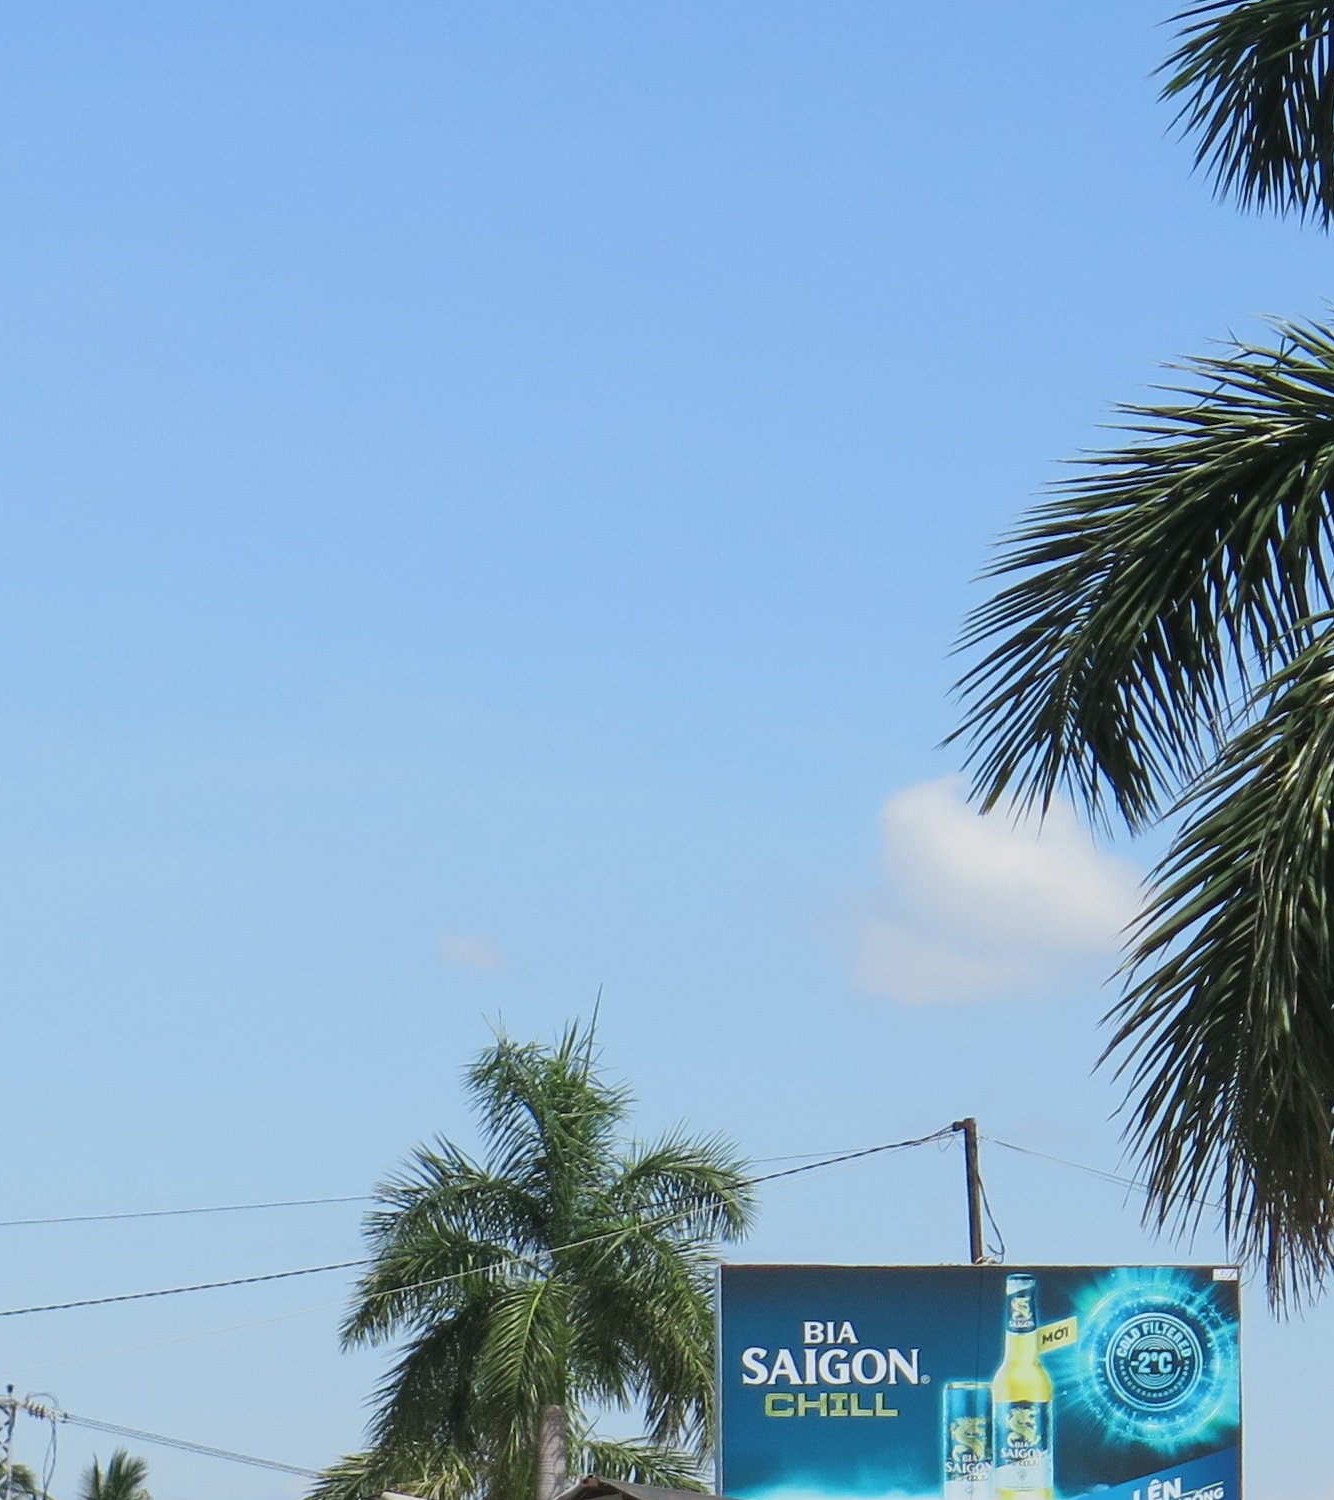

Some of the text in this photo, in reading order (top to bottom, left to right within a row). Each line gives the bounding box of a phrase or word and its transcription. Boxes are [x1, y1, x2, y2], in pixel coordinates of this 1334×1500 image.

[803, 1321, 859, 1344] BIA
[1116, 1321, 1192, 1358] COLD FILTERED
[741, 1347, 919, 1386] SAIGON
[764, 1391, 899, 1418] CHILL
